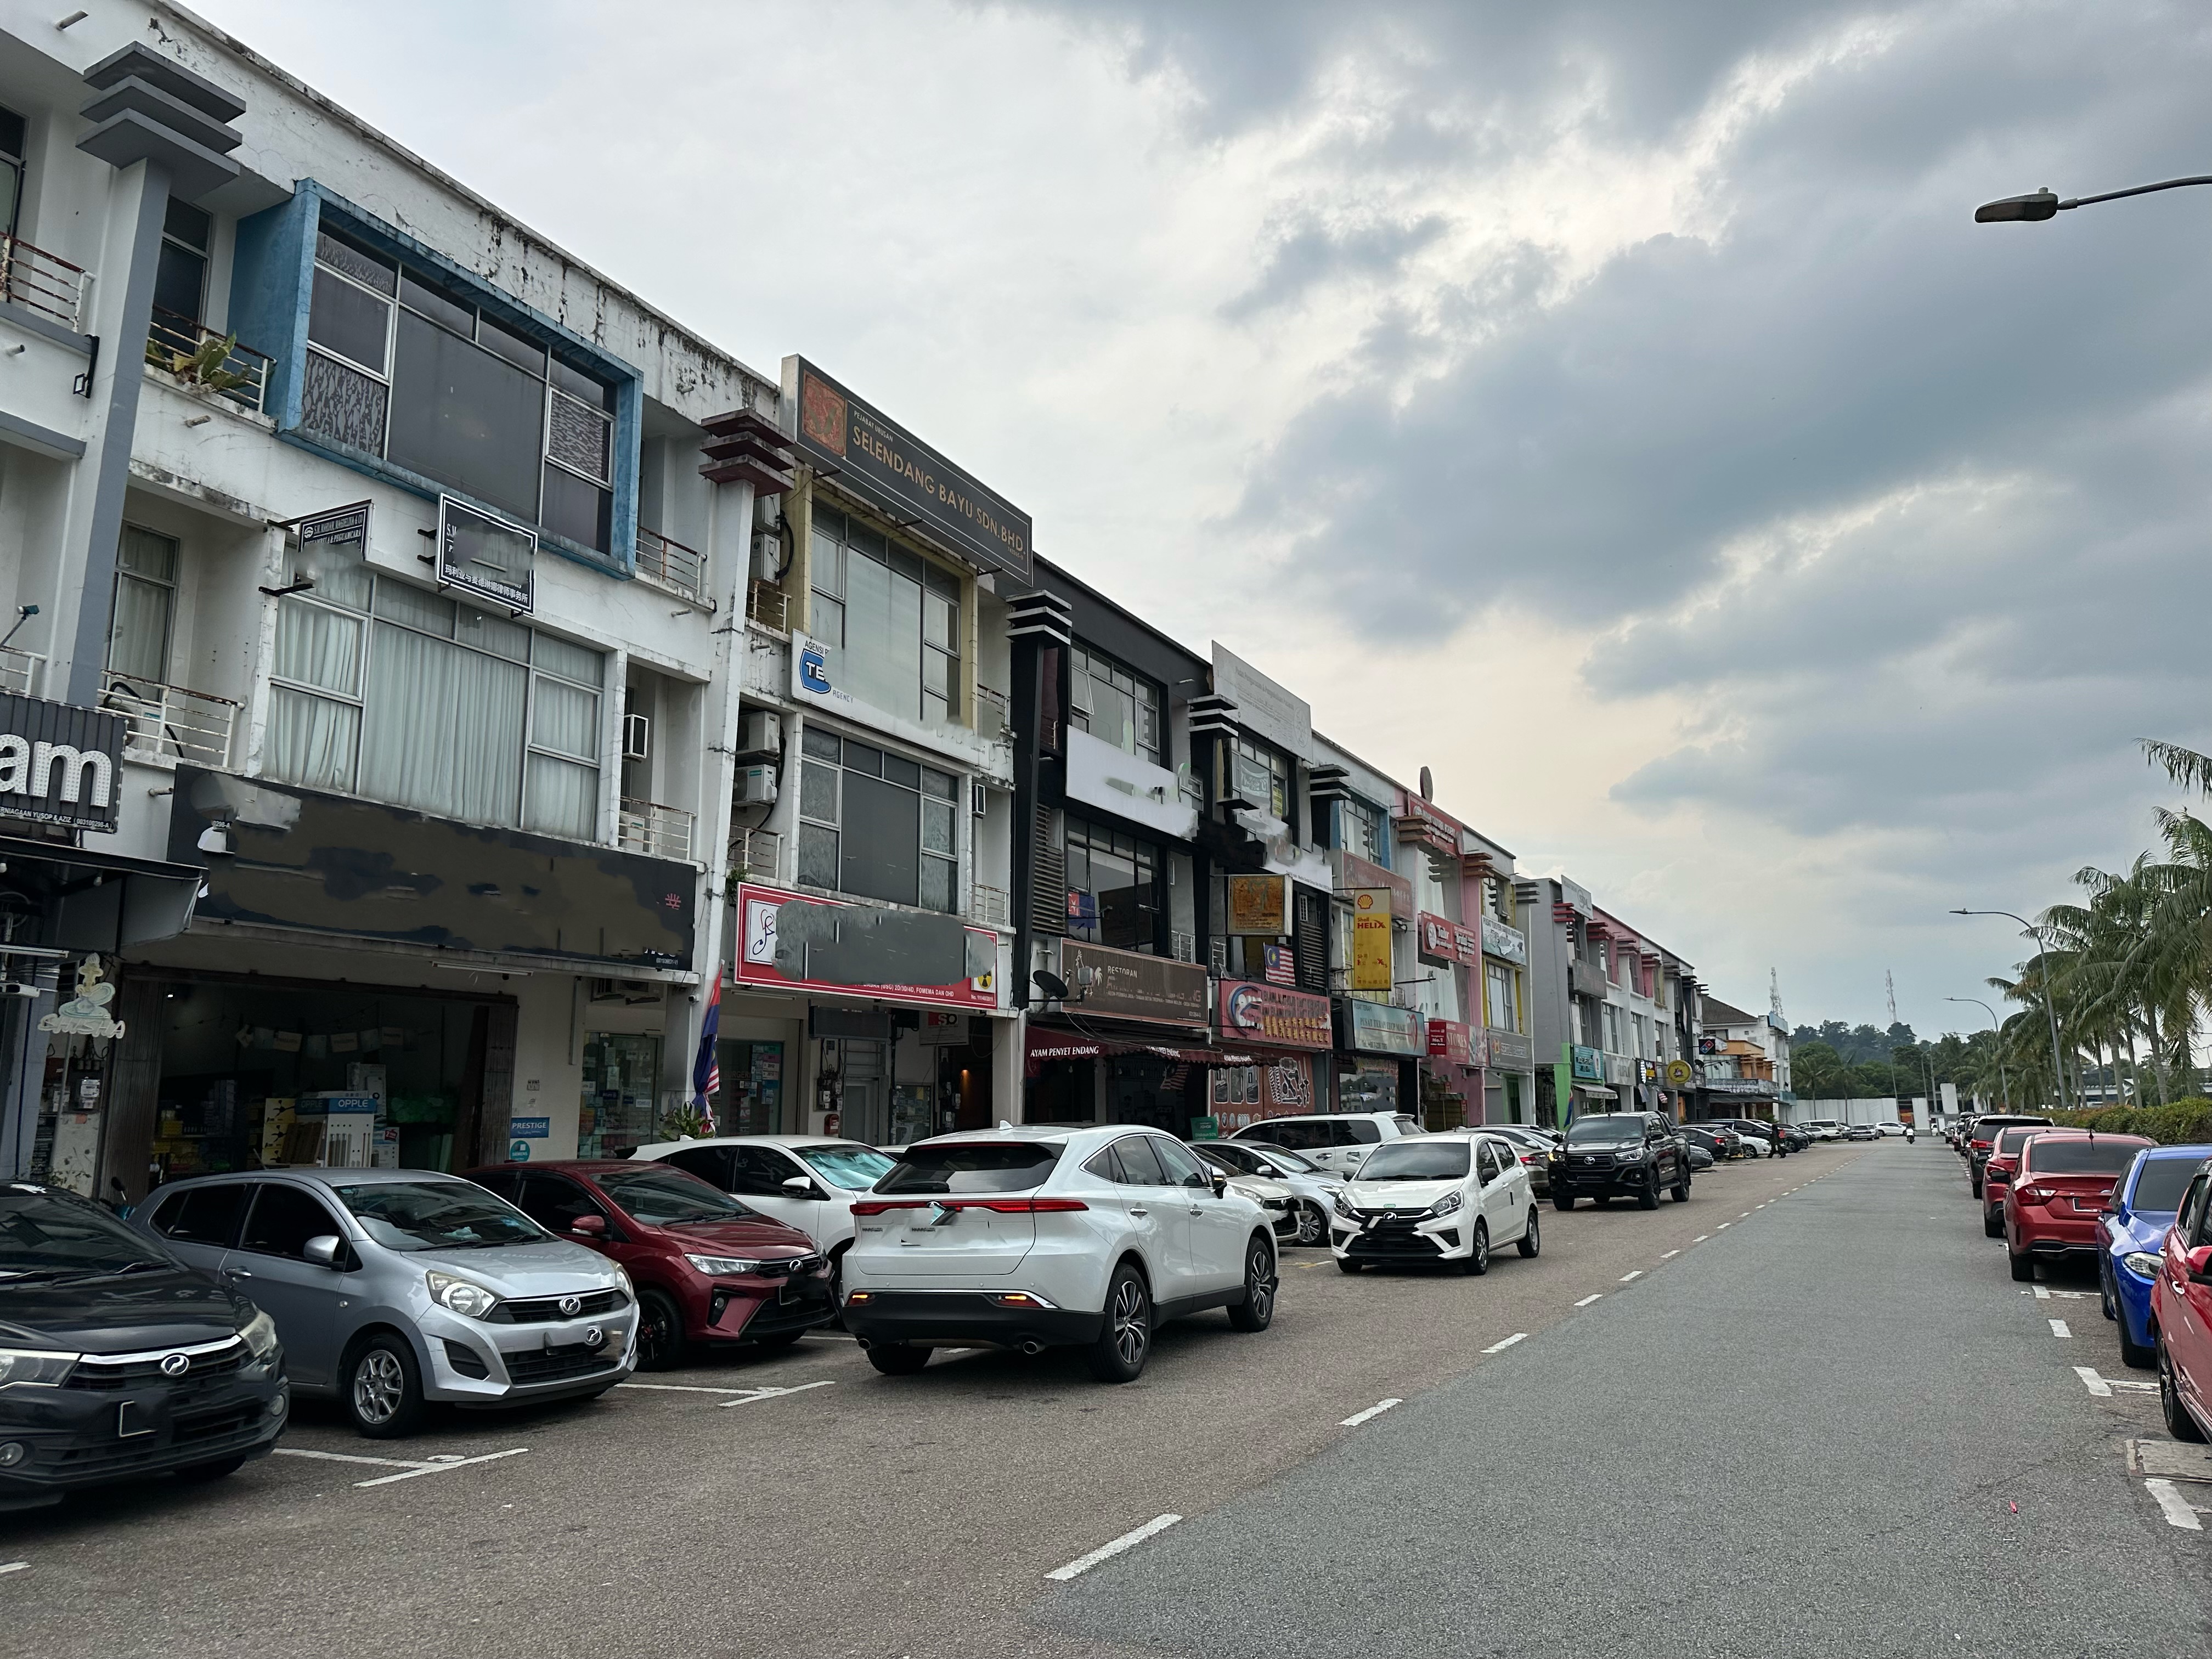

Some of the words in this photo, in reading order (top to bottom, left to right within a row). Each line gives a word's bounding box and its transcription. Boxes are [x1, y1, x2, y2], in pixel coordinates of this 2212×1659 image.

[854, 410, 874, 429] PEJABAT
[875, 425, 893, 442] URUSAN
[853, 425, 935, 494] SELENDANG
[939, 483, 973, 518] BAYU
[805, 640, 823, 654] AGENSI
[833, 690, 854, 703] AGENCY
[33, 811, 52, 820] YUSOP
[37, 1013, 125, 1039] SHISHA
[1361, 1018, 1372, 1026] PUSAT
[1447, 1032, 1467, 1048] STORES
[1030, 1048, 1047, 1057] AYAM
[1048, 1047, 1071, 1056] PENYET
[1072, 1046, 1099, 1055] ENDANG
[338, 1099, 368, 1108] OPPLE
